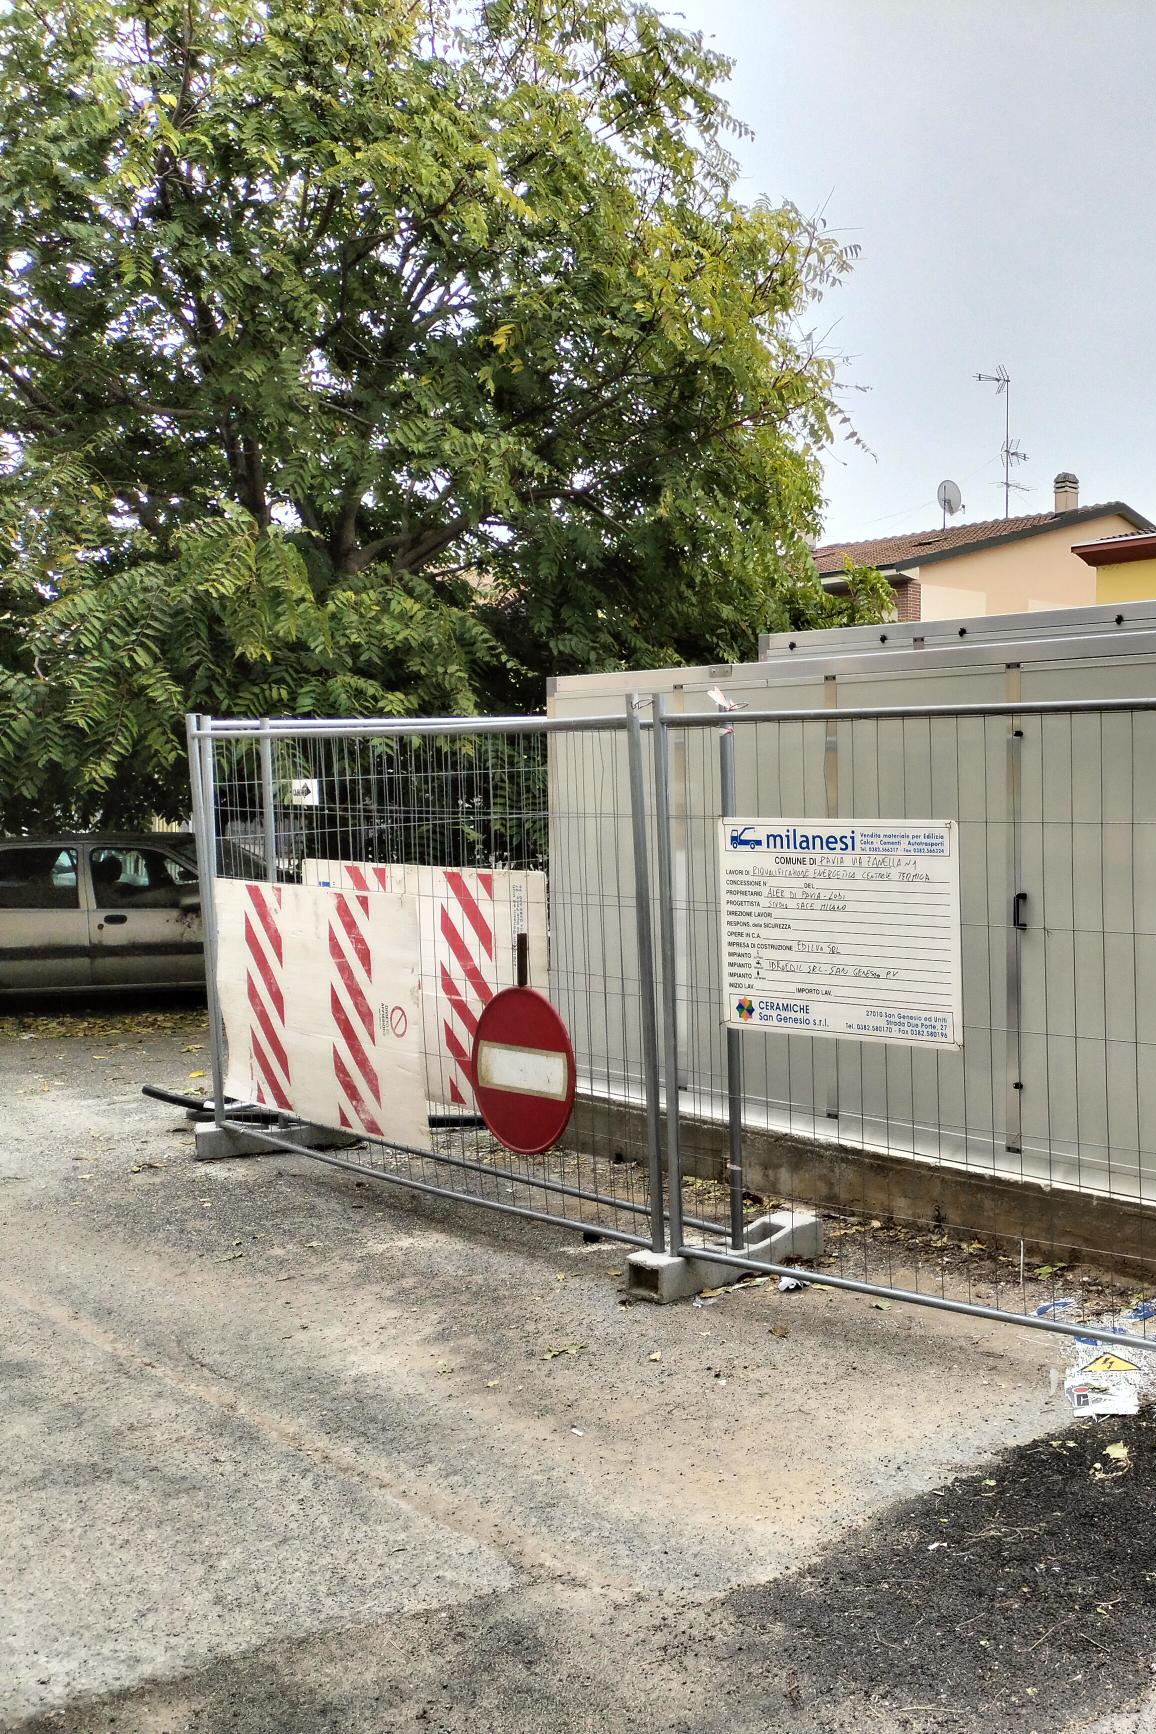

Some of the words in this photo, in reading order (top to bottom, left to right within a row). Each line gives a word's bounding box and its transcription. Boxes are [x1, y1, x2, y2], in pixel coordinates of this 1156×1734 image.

[766, 828, 855, 851] milanesi
[774, 856, 807, 866] COMUNE
[820, 856, 844, 865] PAVIA
[756, 943, 793, 951] COSTRUZIONE
[728, 951, 752, 959] IMPIANTO
[796, 987, 820, 995] IMPORTO
[758, 1000, 810, 1014] CERAMICHE
[758, 1012, 774, 1021] San
[776, 1014, 810, 1025] Genesio
[812, 1019, 830, 1027] s.r.l.
[866, 1010, 883, 1018] 27010
[897, 1013, 922, 1021] Genesio
[885, 1019, 906, 1027] Strada
